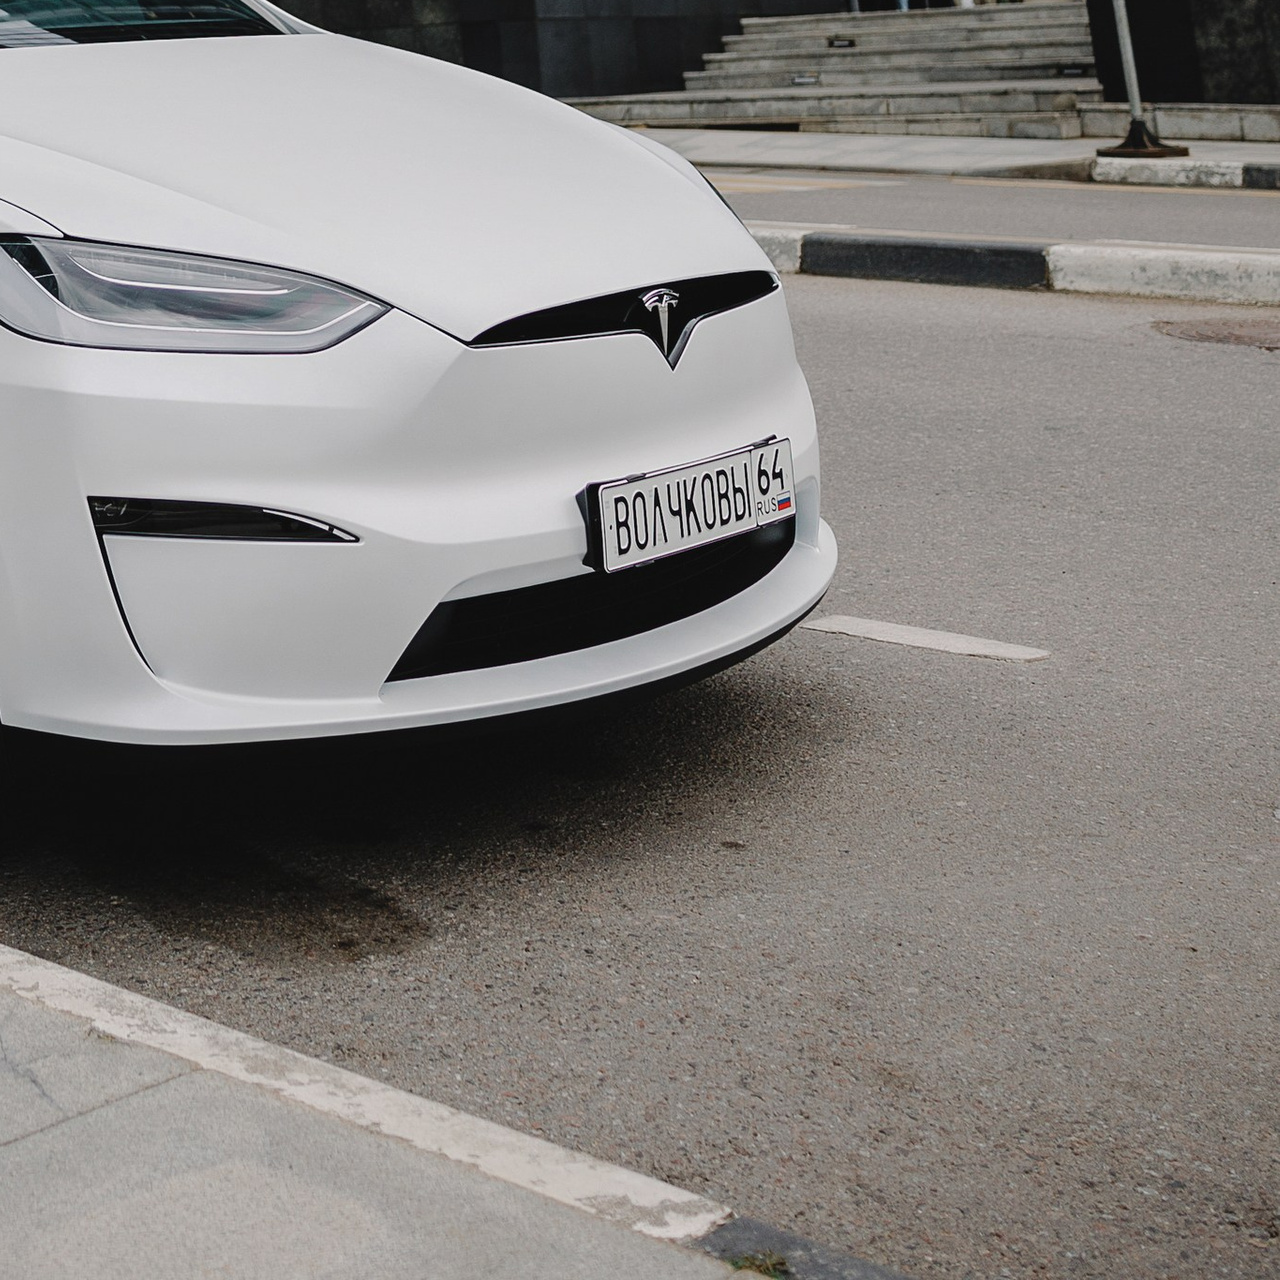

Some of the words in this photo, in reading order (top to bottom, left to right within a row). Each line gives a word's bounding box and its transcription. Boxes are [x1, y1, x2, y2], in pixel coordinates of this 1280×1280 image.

[614, 462, 751, 556] ВОЛЧКОВЫ
[757, 448, 785, 496] 64
[756, 496, 778, 517] RUS
